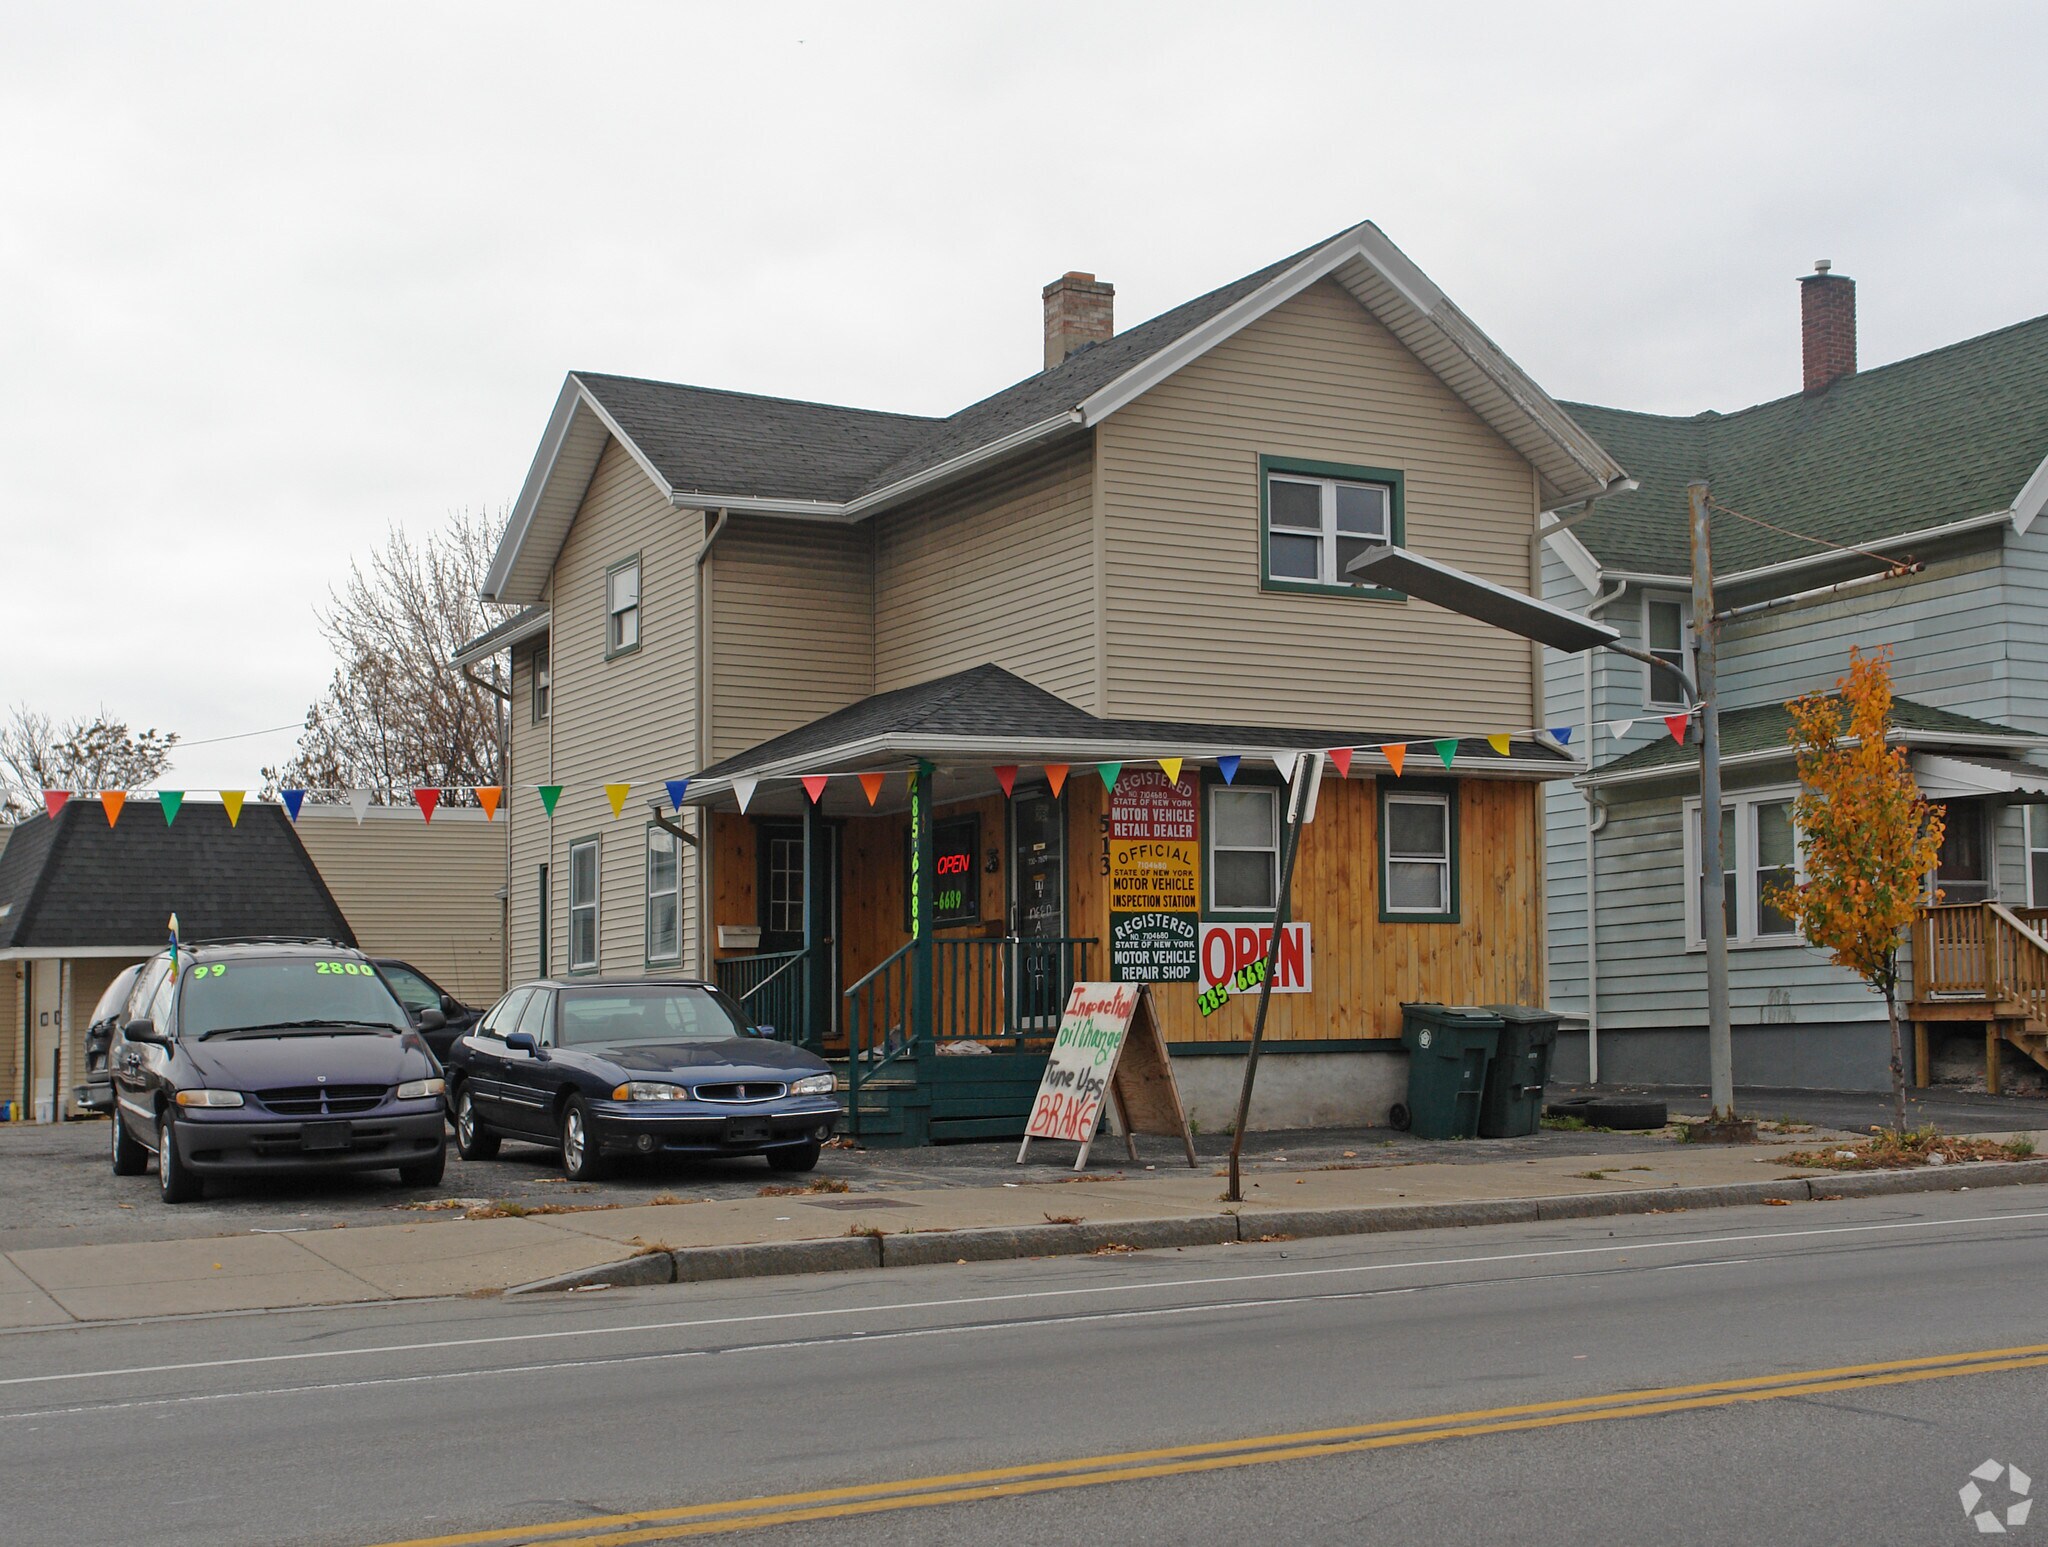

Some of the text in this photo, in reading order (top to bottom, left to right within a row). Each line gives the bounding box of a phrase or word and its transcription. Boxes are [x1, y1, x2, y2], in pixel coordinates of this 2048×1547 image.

[1113, 798, 1137, 806] STATE
[1152, 799, 1170, 807] NEW
[1172, 800, 1193, 808] YORK
[1111, 807, 1195, 823] MOTOR VEHICLE
[1114, 822, 1193, 838] RETAIL DEALER
[1118, 844, 1191, 865] OFFICIAL
[937, 853, 971, 875] OPEN
[1153, 869, 1170, 877] NEW
[1172, 869, 1194, 877] YORK
[1113, 878, 1195, 891] MOTOR VEHICLE
[1112, 894, 1196, 908] INSPECTION STATION
[1114, 913, 1195, 940] REGISTERED
[1115, 941, 1139, 949] STATE
[1141, 941, 1152, 949] OF
[1154, 941, 1171, 949] NEW
[1114, 950, 1197, 965] MOTOR VEHICLE
[1201, 927, 1305, 988] OPEN
[193, 961, 375, 980] 99 2800
[1121, 966, 1191, 980] REPAIR SHOP
[1197, 956, 1268, 1016] 285-668
